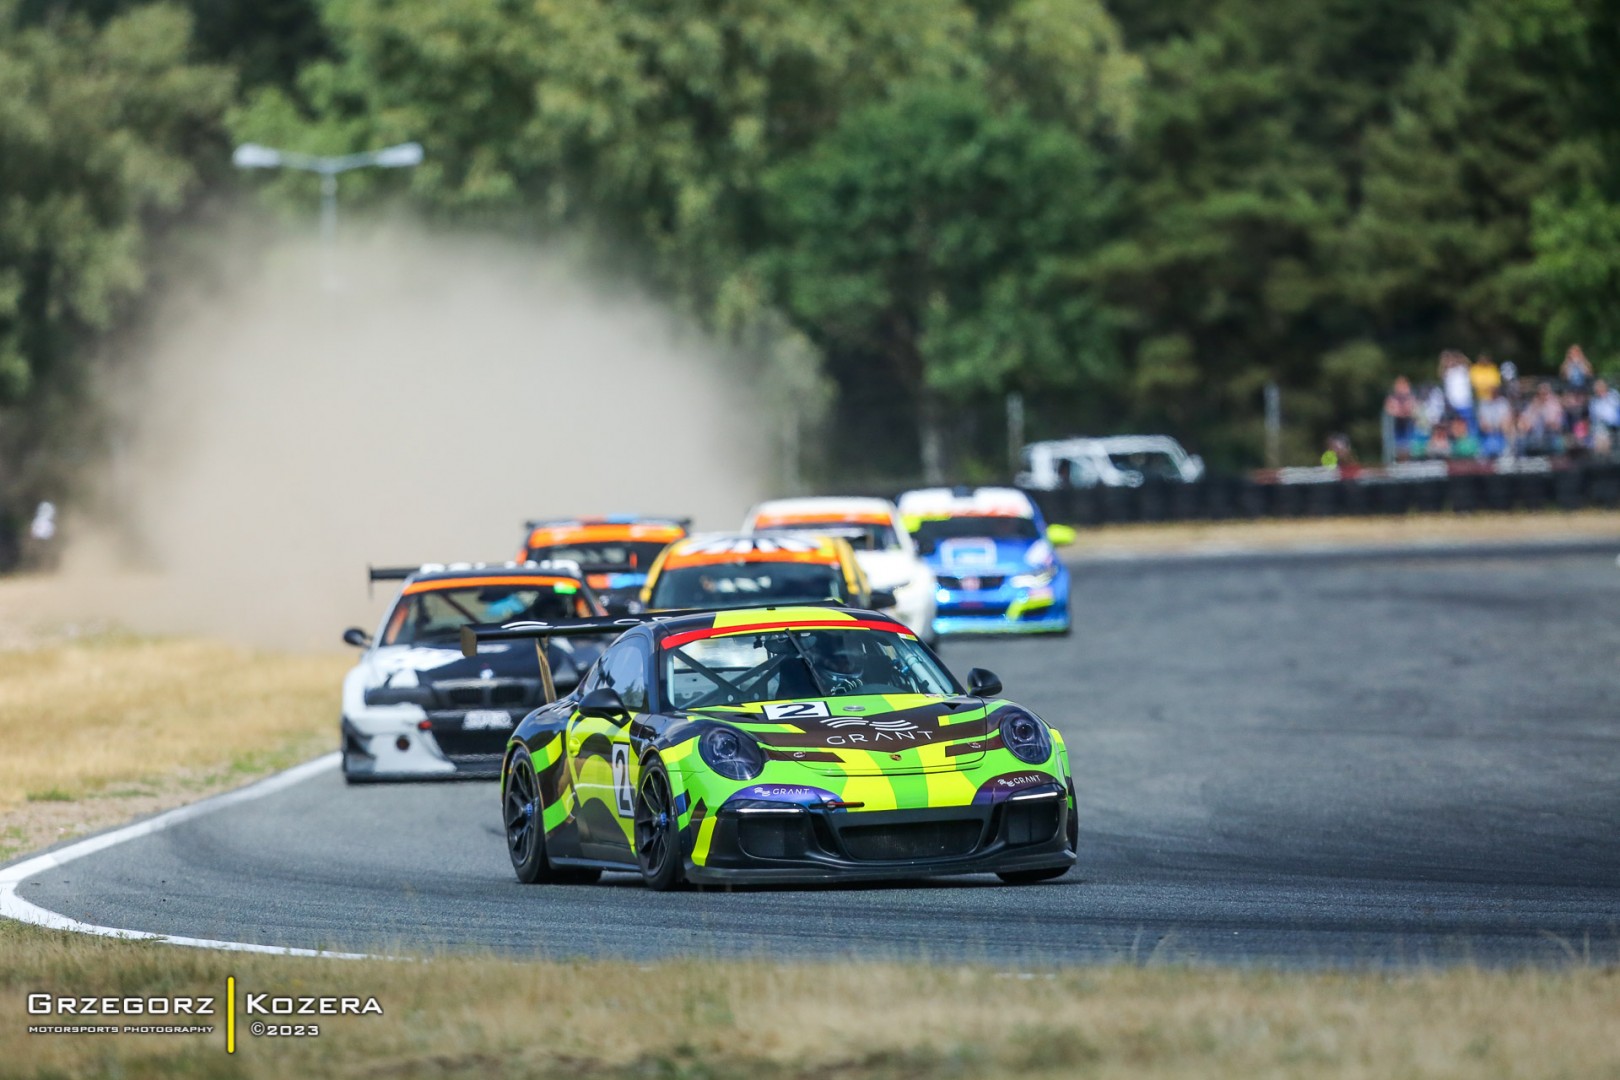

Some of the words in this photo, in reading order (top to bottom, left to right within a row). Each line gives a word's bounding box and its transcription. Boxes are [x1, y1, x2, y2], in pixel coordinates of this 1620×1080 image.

[776, 703, 819, 718] 2
[826, 730, 934, 746] GRANT
[615, 749, 632, 811] 2
[1013, 774, 1041, 785] GRANT
